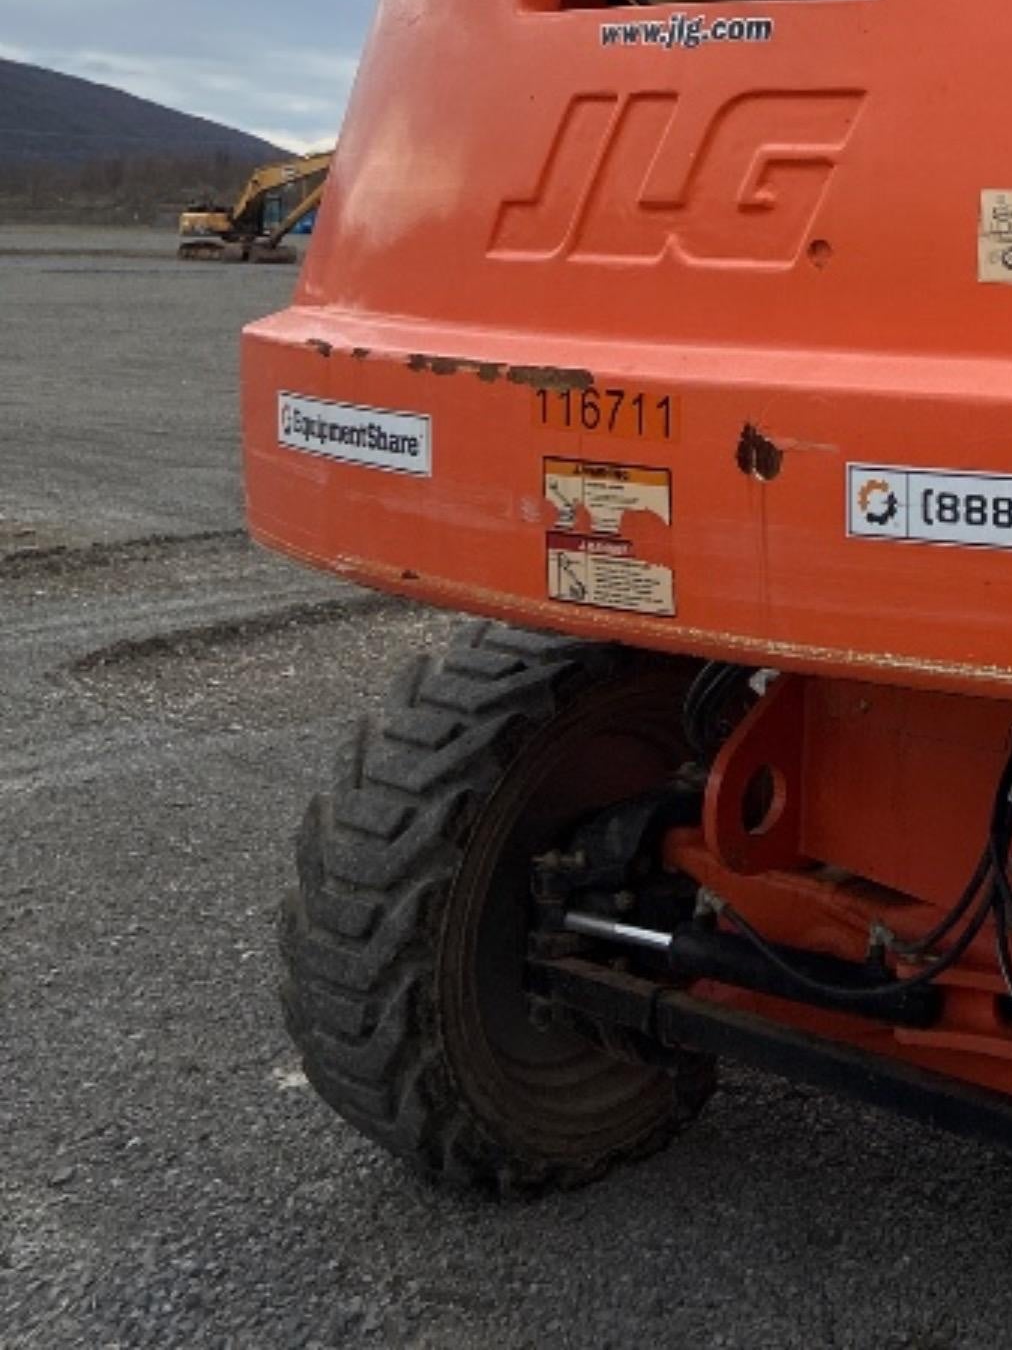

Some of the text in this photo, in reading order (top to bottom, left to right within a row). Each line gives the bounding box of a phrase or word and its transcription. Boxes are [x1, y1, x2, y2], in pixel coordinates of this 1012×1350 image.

[601, 14, 772, 48] www.jlg.com
[486, 88, 868, 270] JLG
[292, 407, 419, 457] EquipmentShare
[536, 387, 671, 439] 116711
